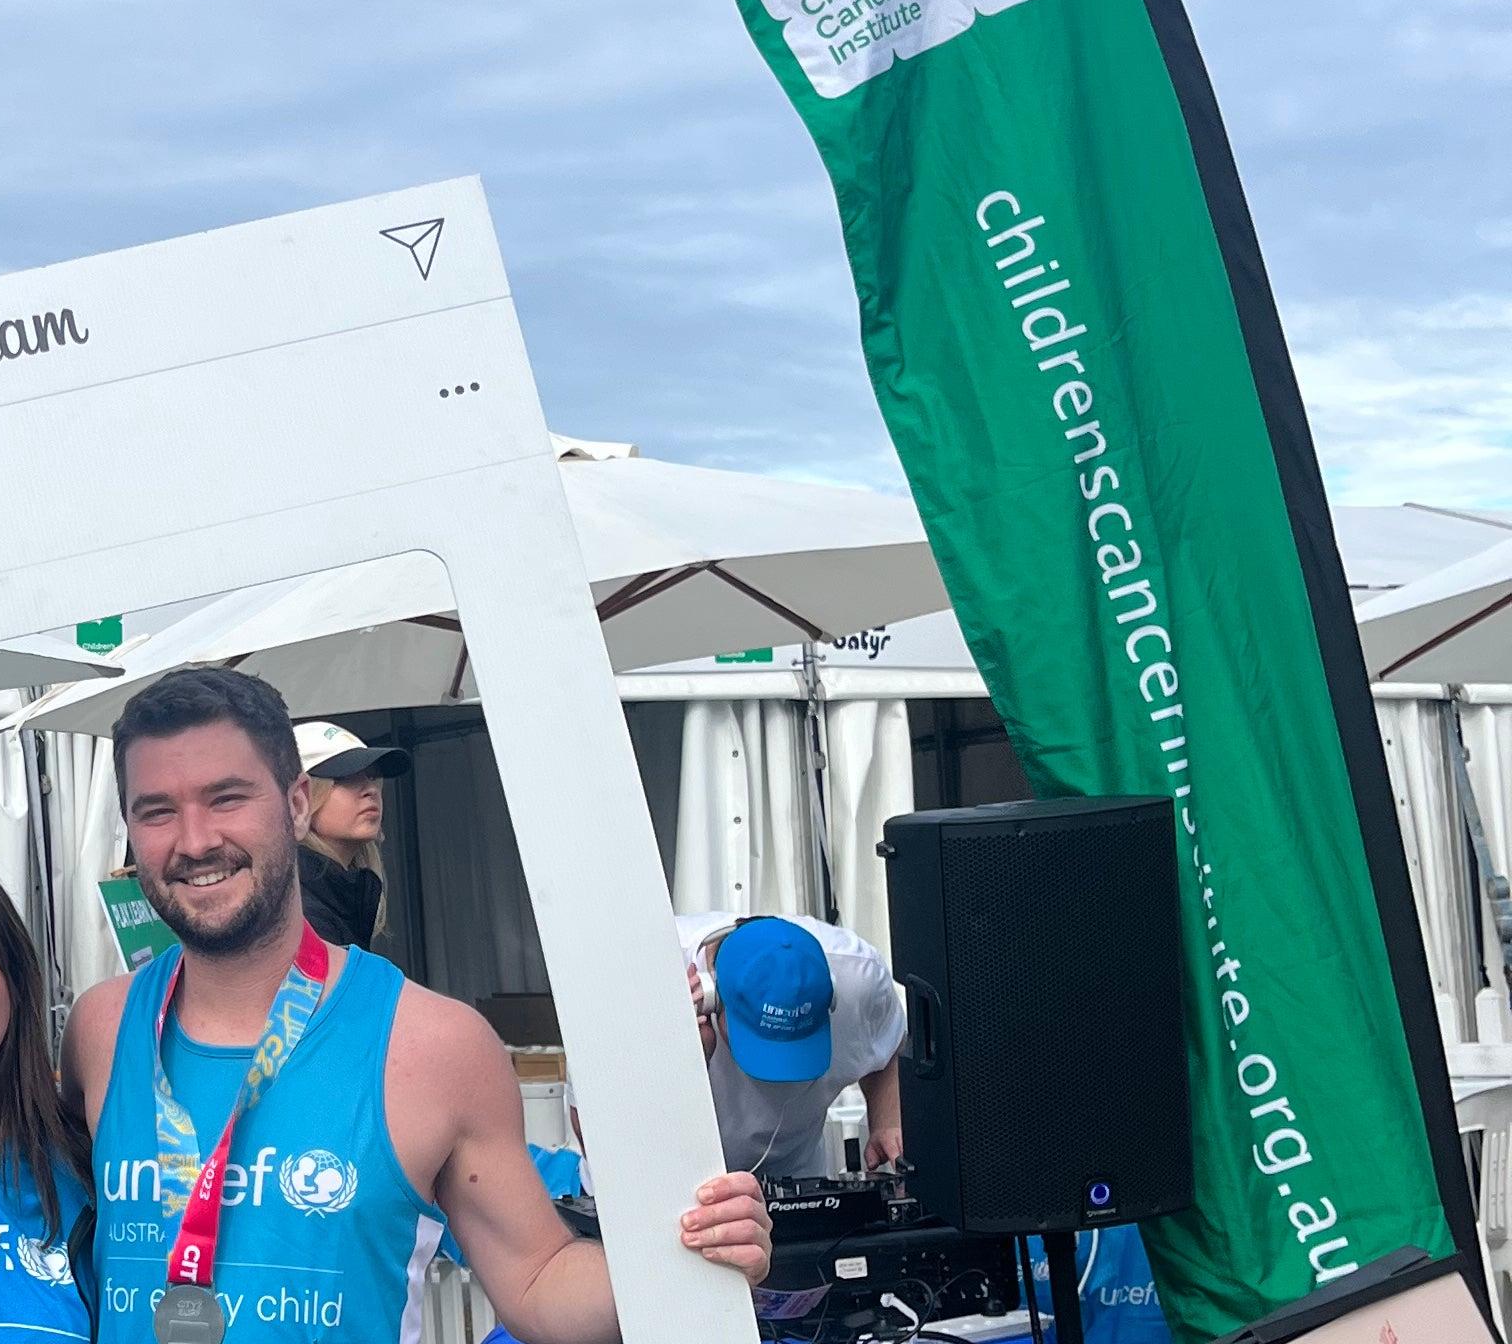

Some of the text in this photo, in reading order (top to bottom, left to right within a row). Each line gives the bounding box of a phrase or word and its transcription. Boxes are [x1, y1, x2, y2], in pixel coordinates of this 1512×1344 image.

[829, 1, 922, 65] Institute
[104, 1147, 277, 1207] unef
[199, 1158, 218, 1200] 2023
[769, 1200, 822, 1212] Pioneer
[105, 1278, 138, 1313] for
[256, 1287, 343, 1327] child
